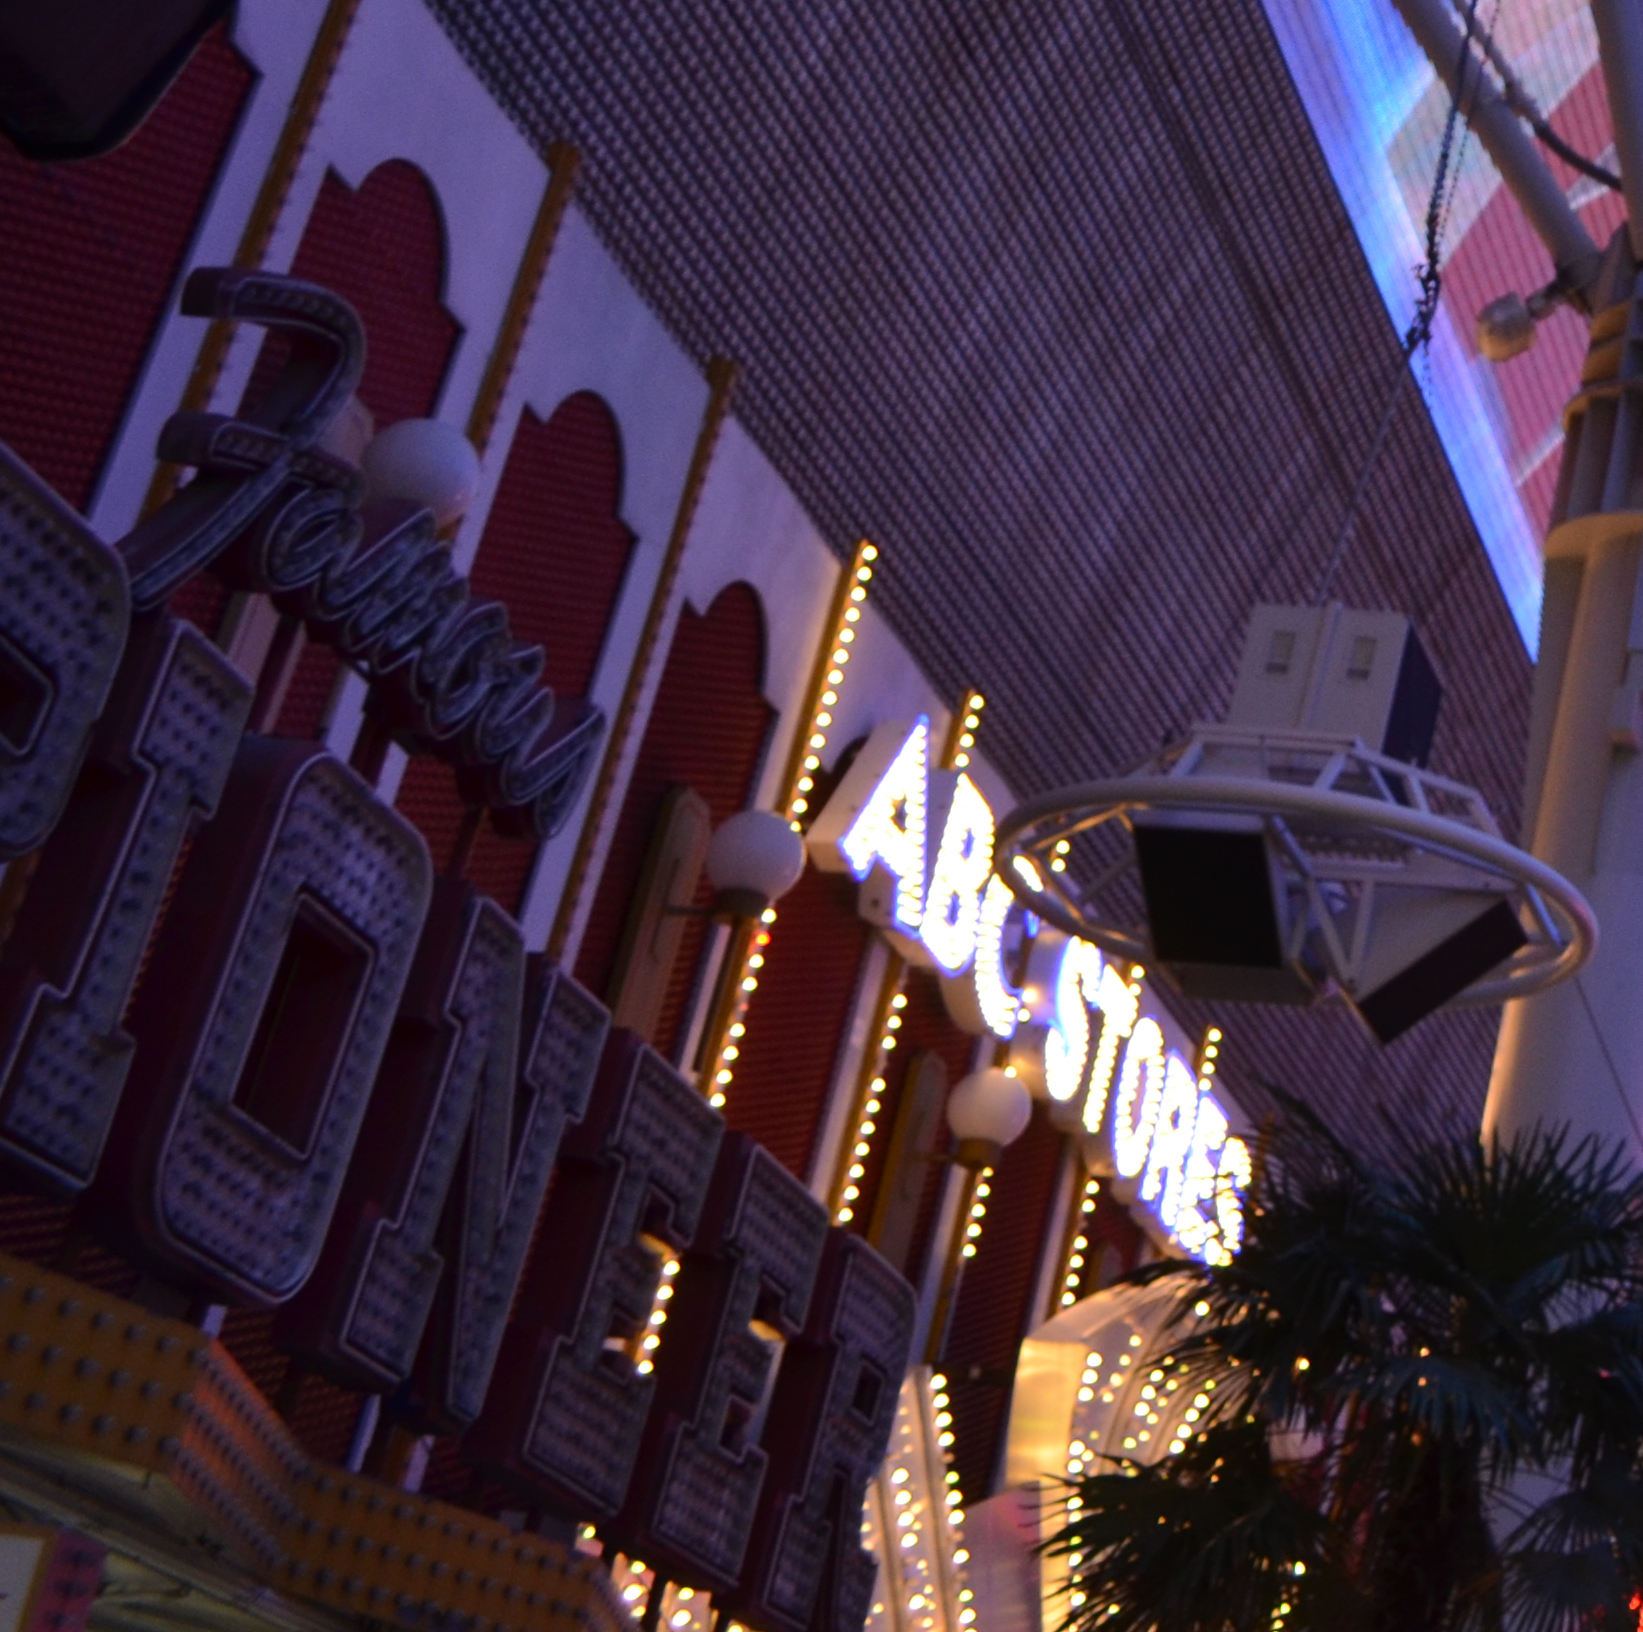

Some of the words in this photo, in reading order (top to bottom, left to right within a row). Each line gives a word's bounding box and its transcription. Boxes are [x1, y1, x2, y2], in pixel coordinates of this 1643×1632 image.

[125, 274, 606, 840] Famous
[836, 713, 1044, 1040] ABC
[1044, 934, 1254, 1268] STORES
